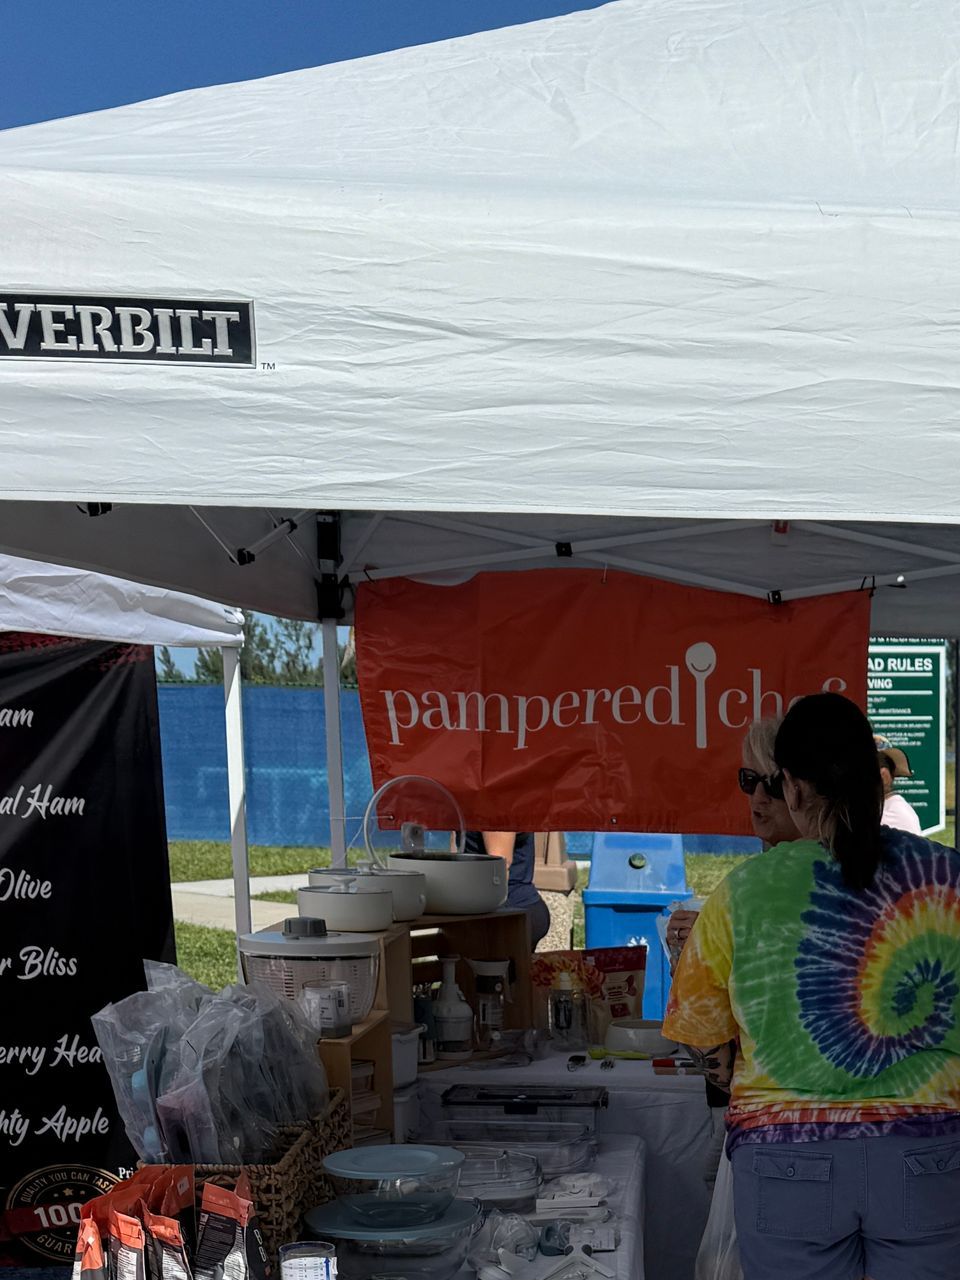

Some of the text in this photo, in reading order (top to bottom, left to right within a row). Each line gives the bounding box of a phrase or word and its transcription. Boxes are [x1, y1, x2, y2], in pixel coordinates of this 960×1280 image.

[887, 658, 933, 671] RULES
[379, 665, 685, 751] pampered
[21, 783, 85, 820] Ham
[0, 867, 52, 901] Olive
[17, 945, 78, 980] Bliss
[49, 1033, 104, 1068] Hea
[34, 1105, 109, 1143] Apple
[21, 1177, 48, 1203] QUALITY
[49, 1171, 68, 1183] YOU
[71, 1171, 90, 1181] CAN
